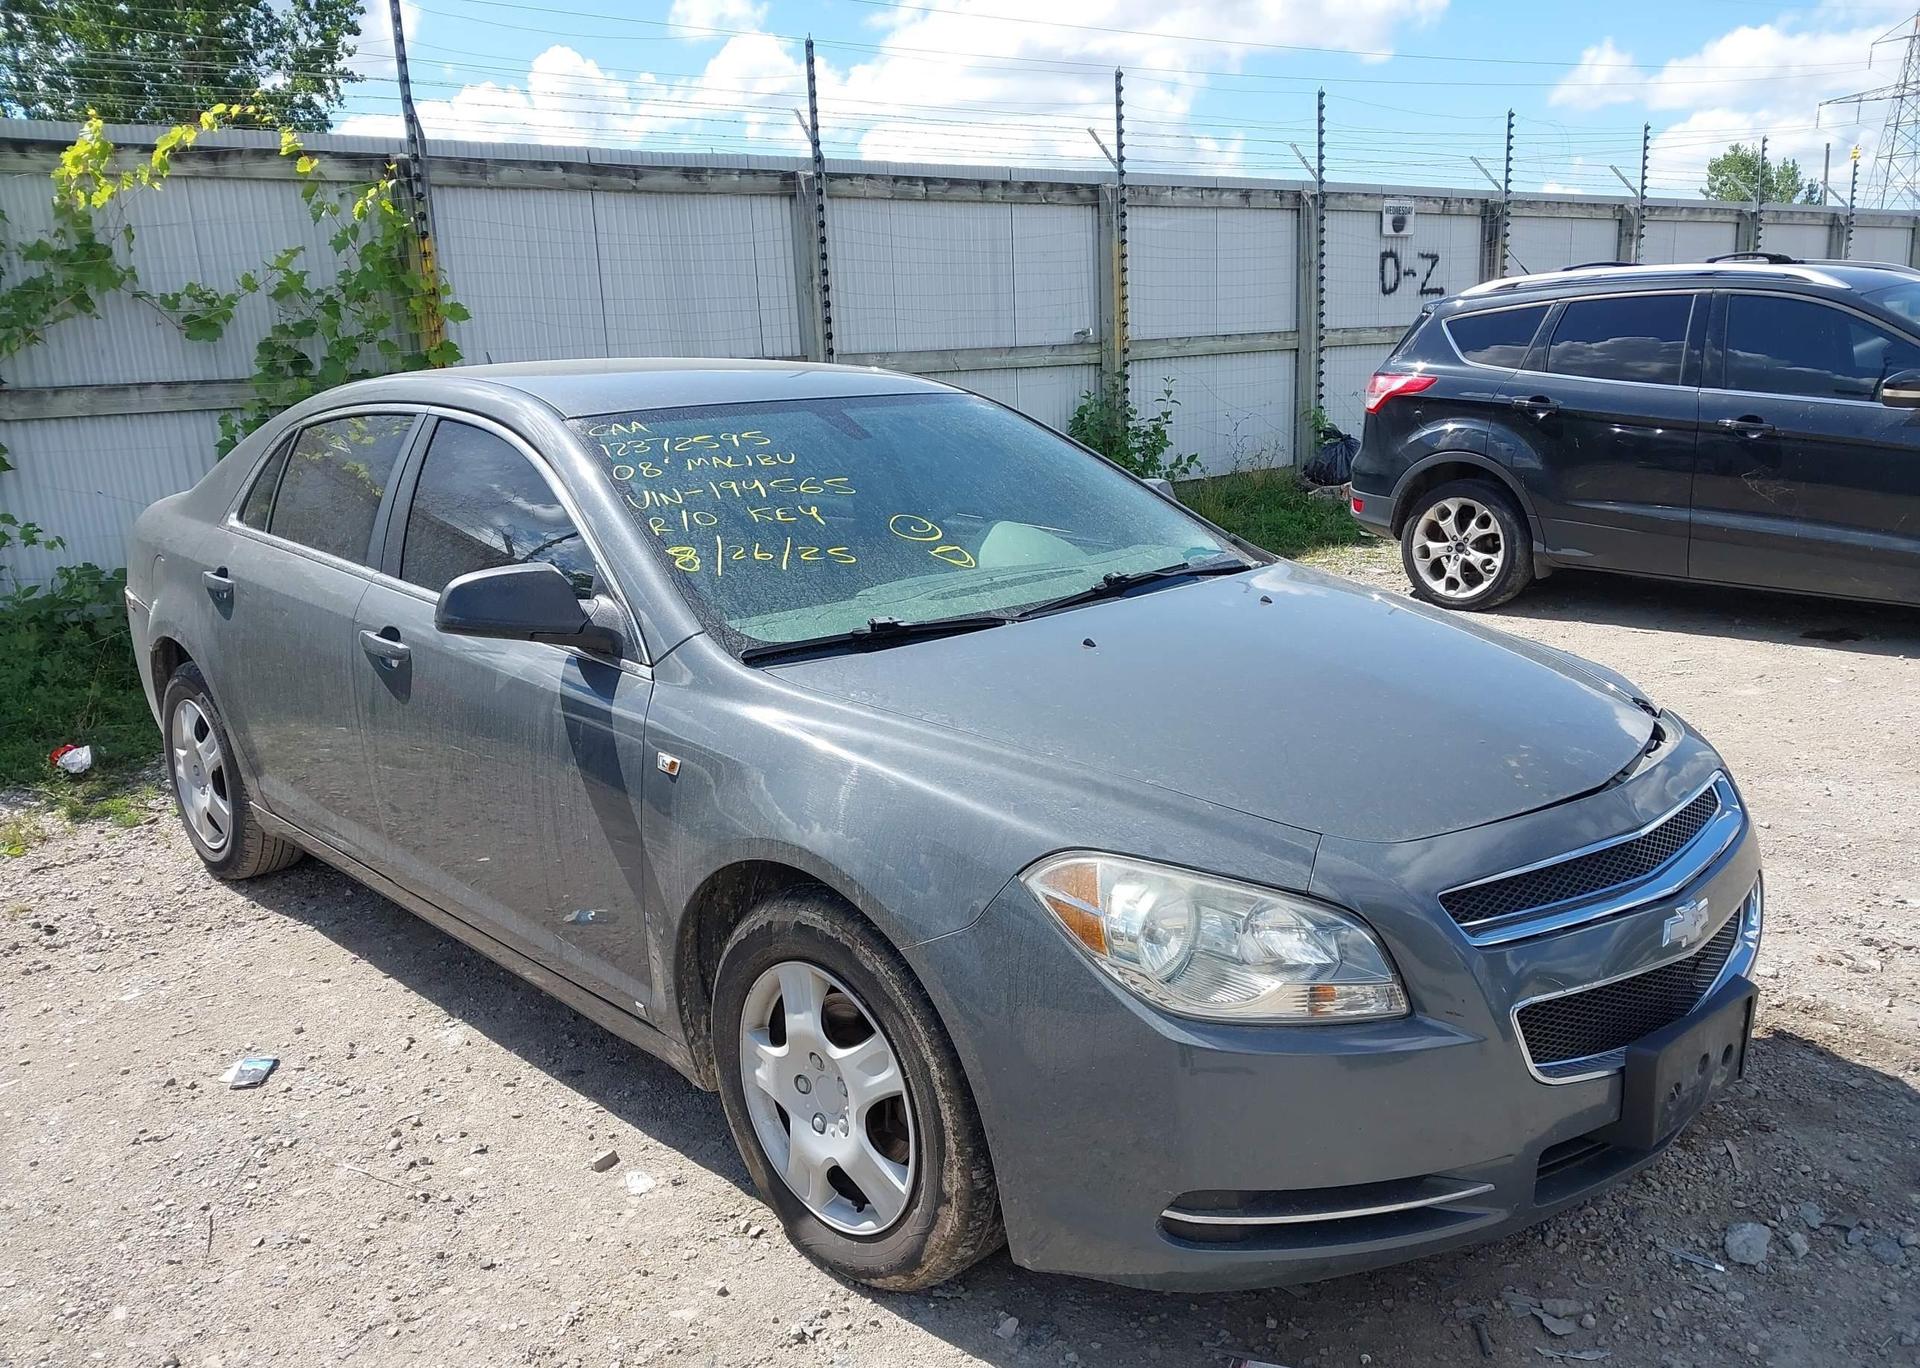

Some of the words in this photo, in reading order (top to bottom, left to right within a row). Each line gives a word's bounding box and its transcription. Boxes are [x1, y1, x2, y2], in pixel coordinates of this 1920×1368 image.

[1384, 205, 1413, 215] WEDNESDAY
[588, 421, 653, 437] CAA
[600, 431, 771, 459] 12372595
[687, 453, 796, 471] MALIBU
[747, 505, 826, 526] KEY
